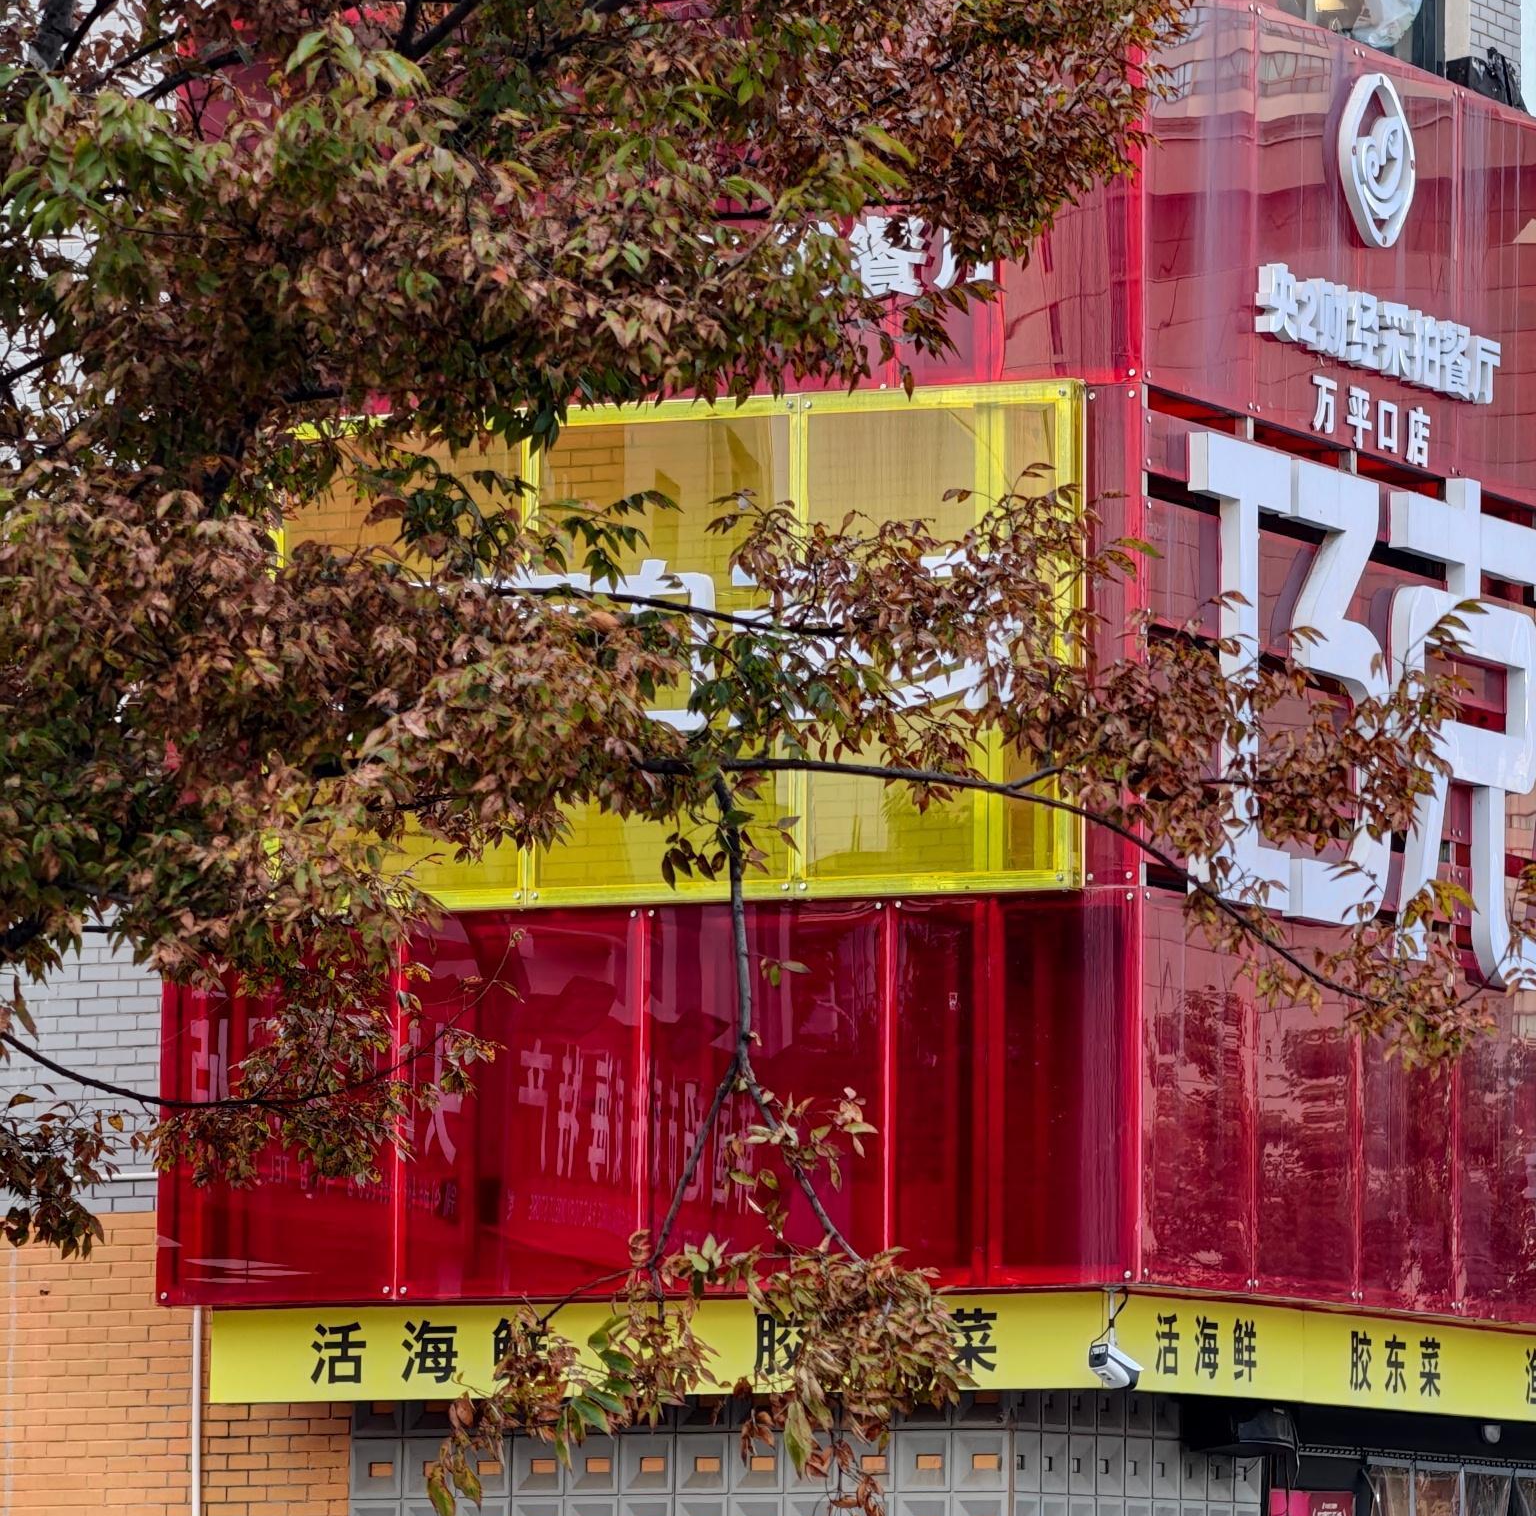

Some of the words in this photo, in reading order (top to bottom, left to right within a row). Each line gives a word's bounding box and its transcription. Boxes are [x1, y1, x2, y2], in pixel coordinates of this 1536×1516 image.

[1255, 263, 1502, 406] 央2财经采拍餐厅
[1312, 374, 1430, 470] 万平口店
[309, 1318, 553, 1385] 活海
[755, 1307, 999, 1375] 胶菜
[1154, 1312, 1259, 1386] 活海鲜
[1348, 1329, 1442, 1399] 胶东菜
